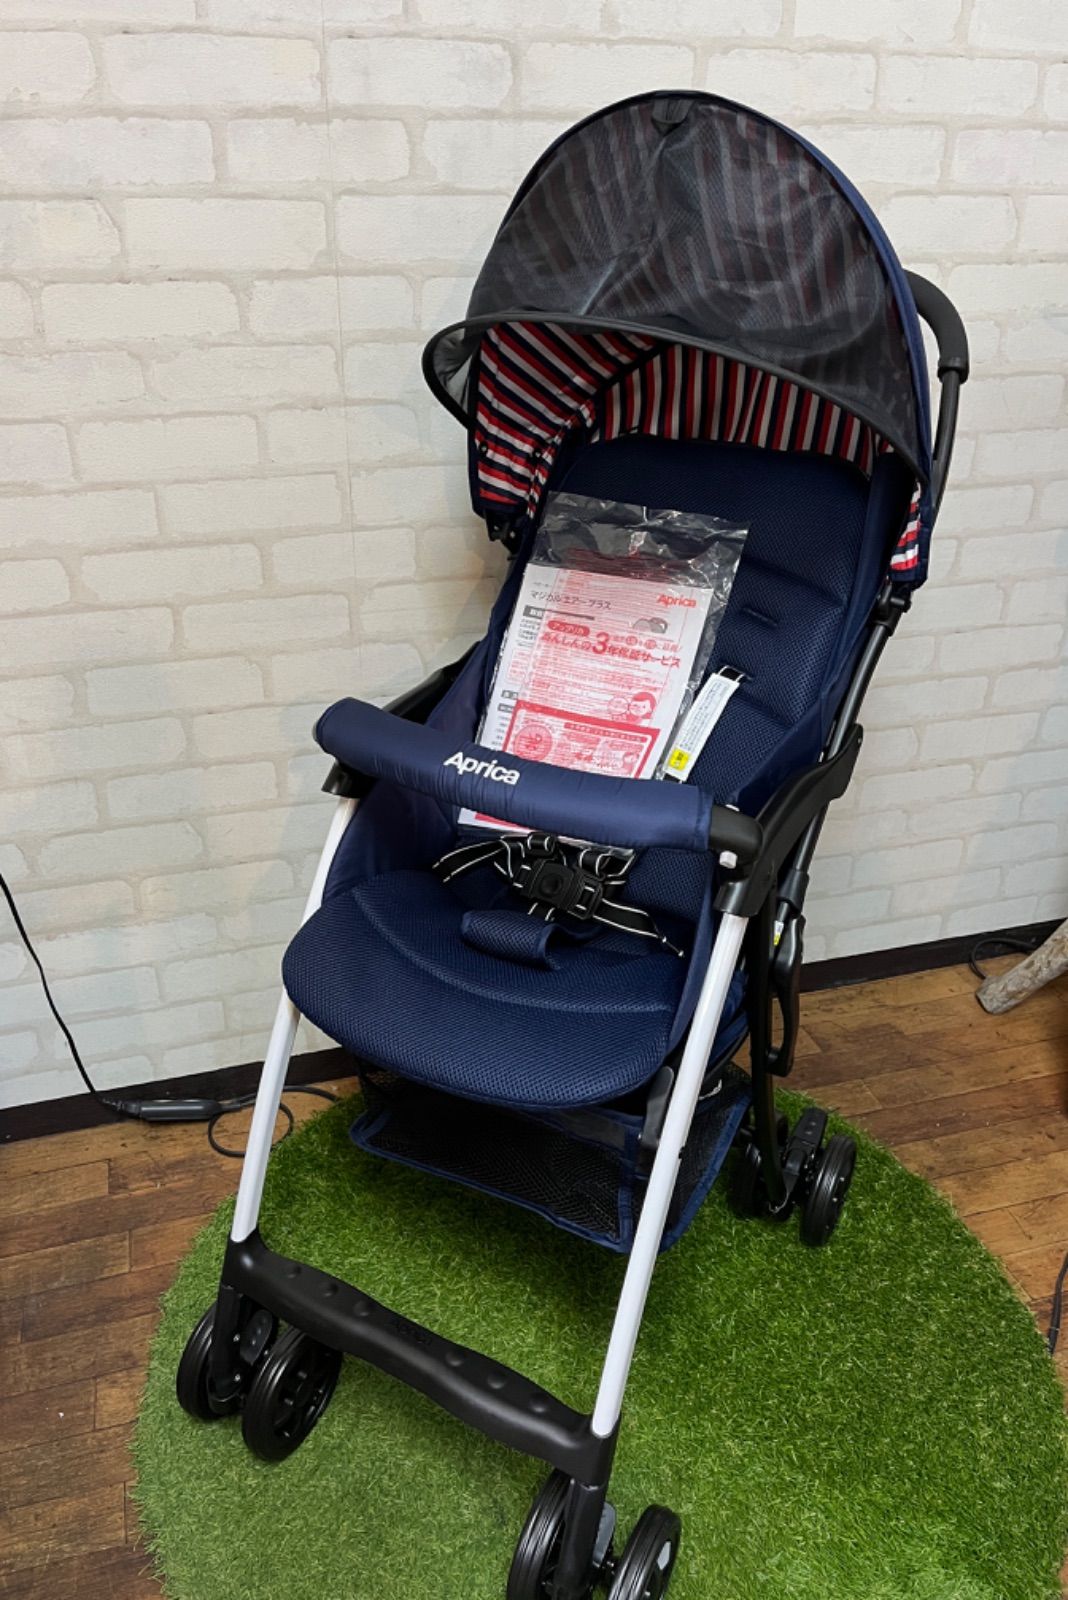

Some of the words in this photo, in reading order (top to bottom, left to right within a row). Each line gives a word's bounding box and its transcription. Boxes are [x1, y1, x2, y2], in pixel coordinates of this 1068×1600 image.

[530, 590, 612, 610] マジカルエアープラス
[656, 593, 697, 608] Aprica
[443, 751, 521, 786] Aprica
